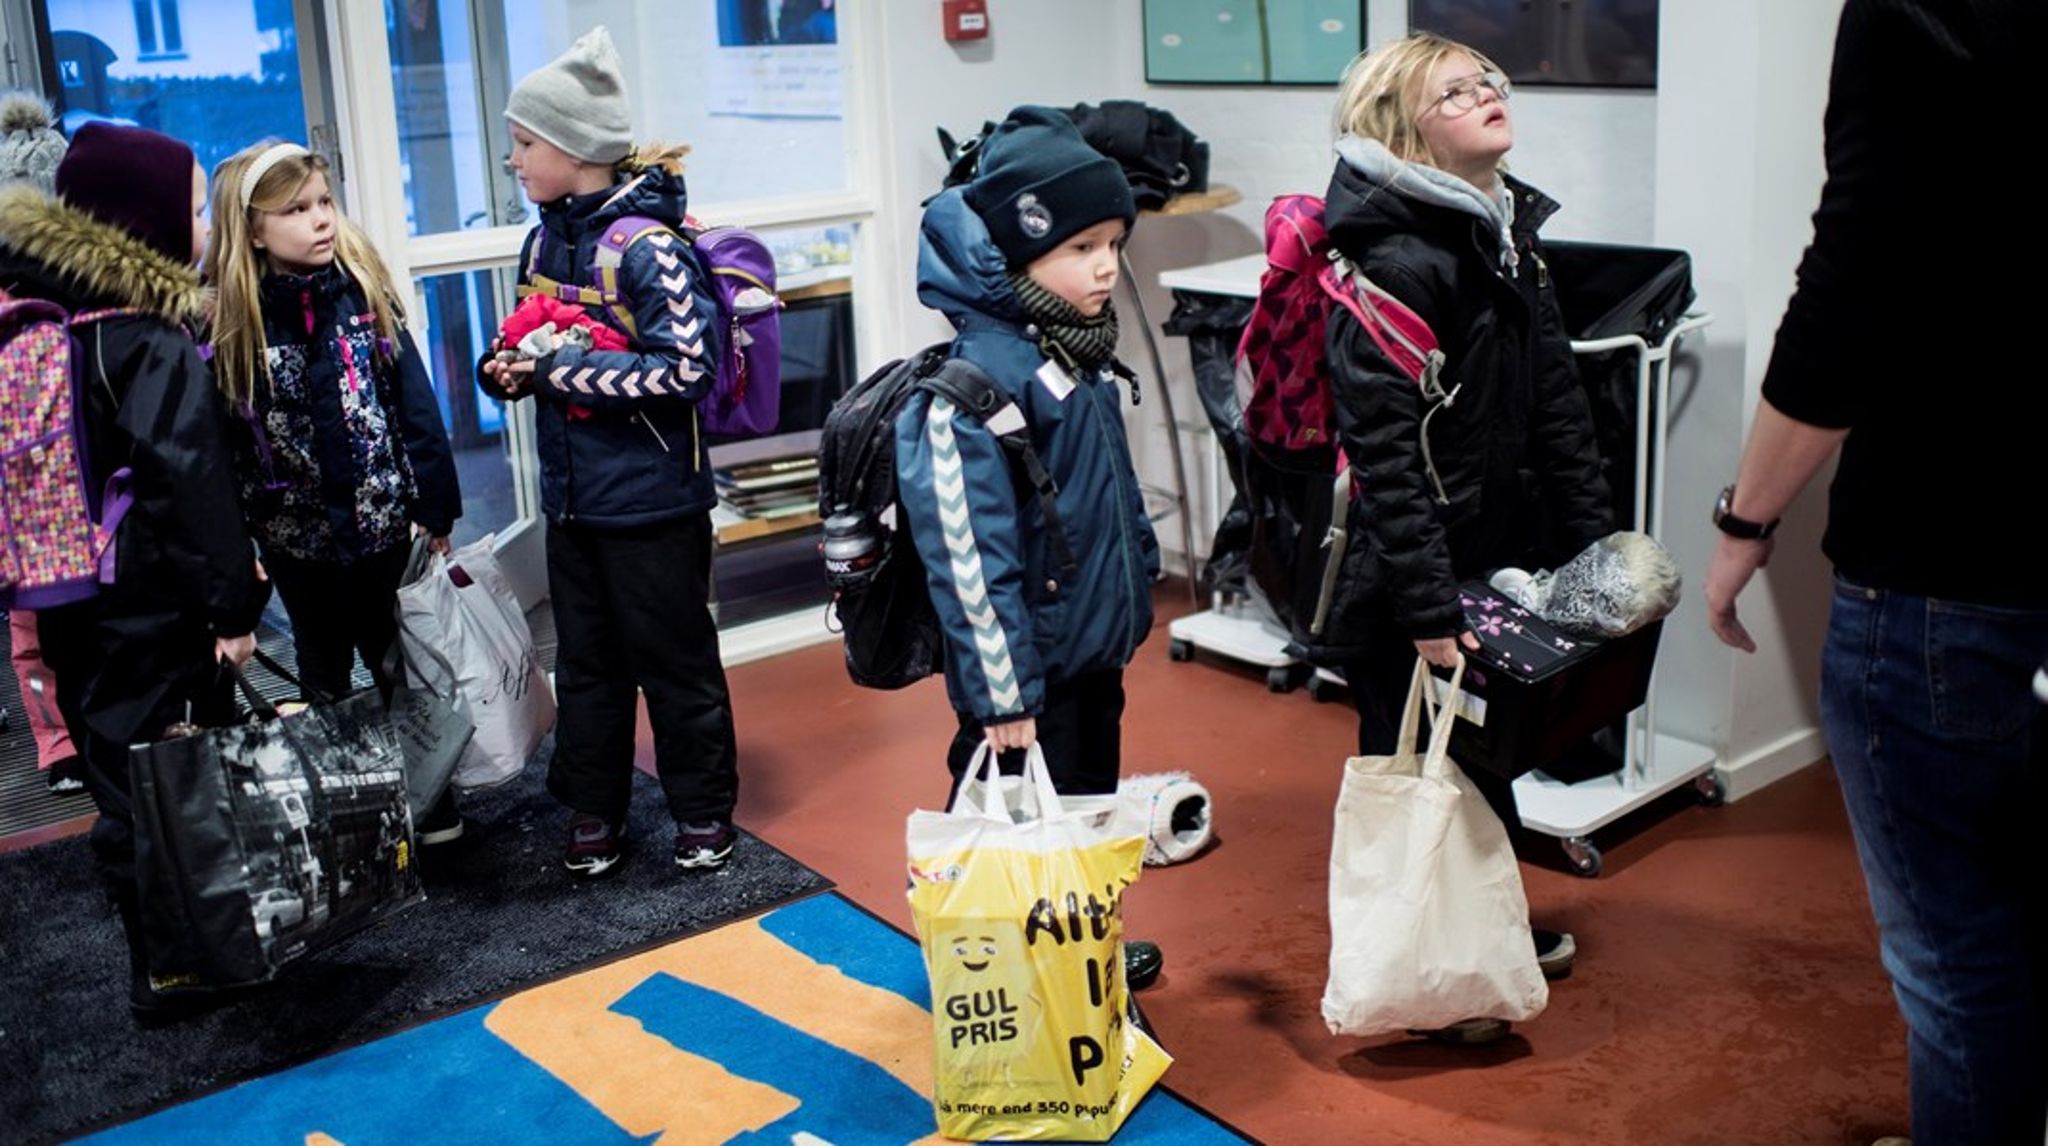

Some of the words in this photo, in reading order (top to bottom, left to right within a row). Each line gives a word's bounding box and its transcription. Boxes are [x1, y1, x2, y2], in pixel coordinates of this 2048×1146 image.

[946, 987, 1018, 1021] GUL
[951, 1017, 1018, 1048] PRIS
[957, 1103, 997, 1116] mere
[1002, 1102, 1032, 1115] end
[1037, 1101, 1069, 1114] 350
